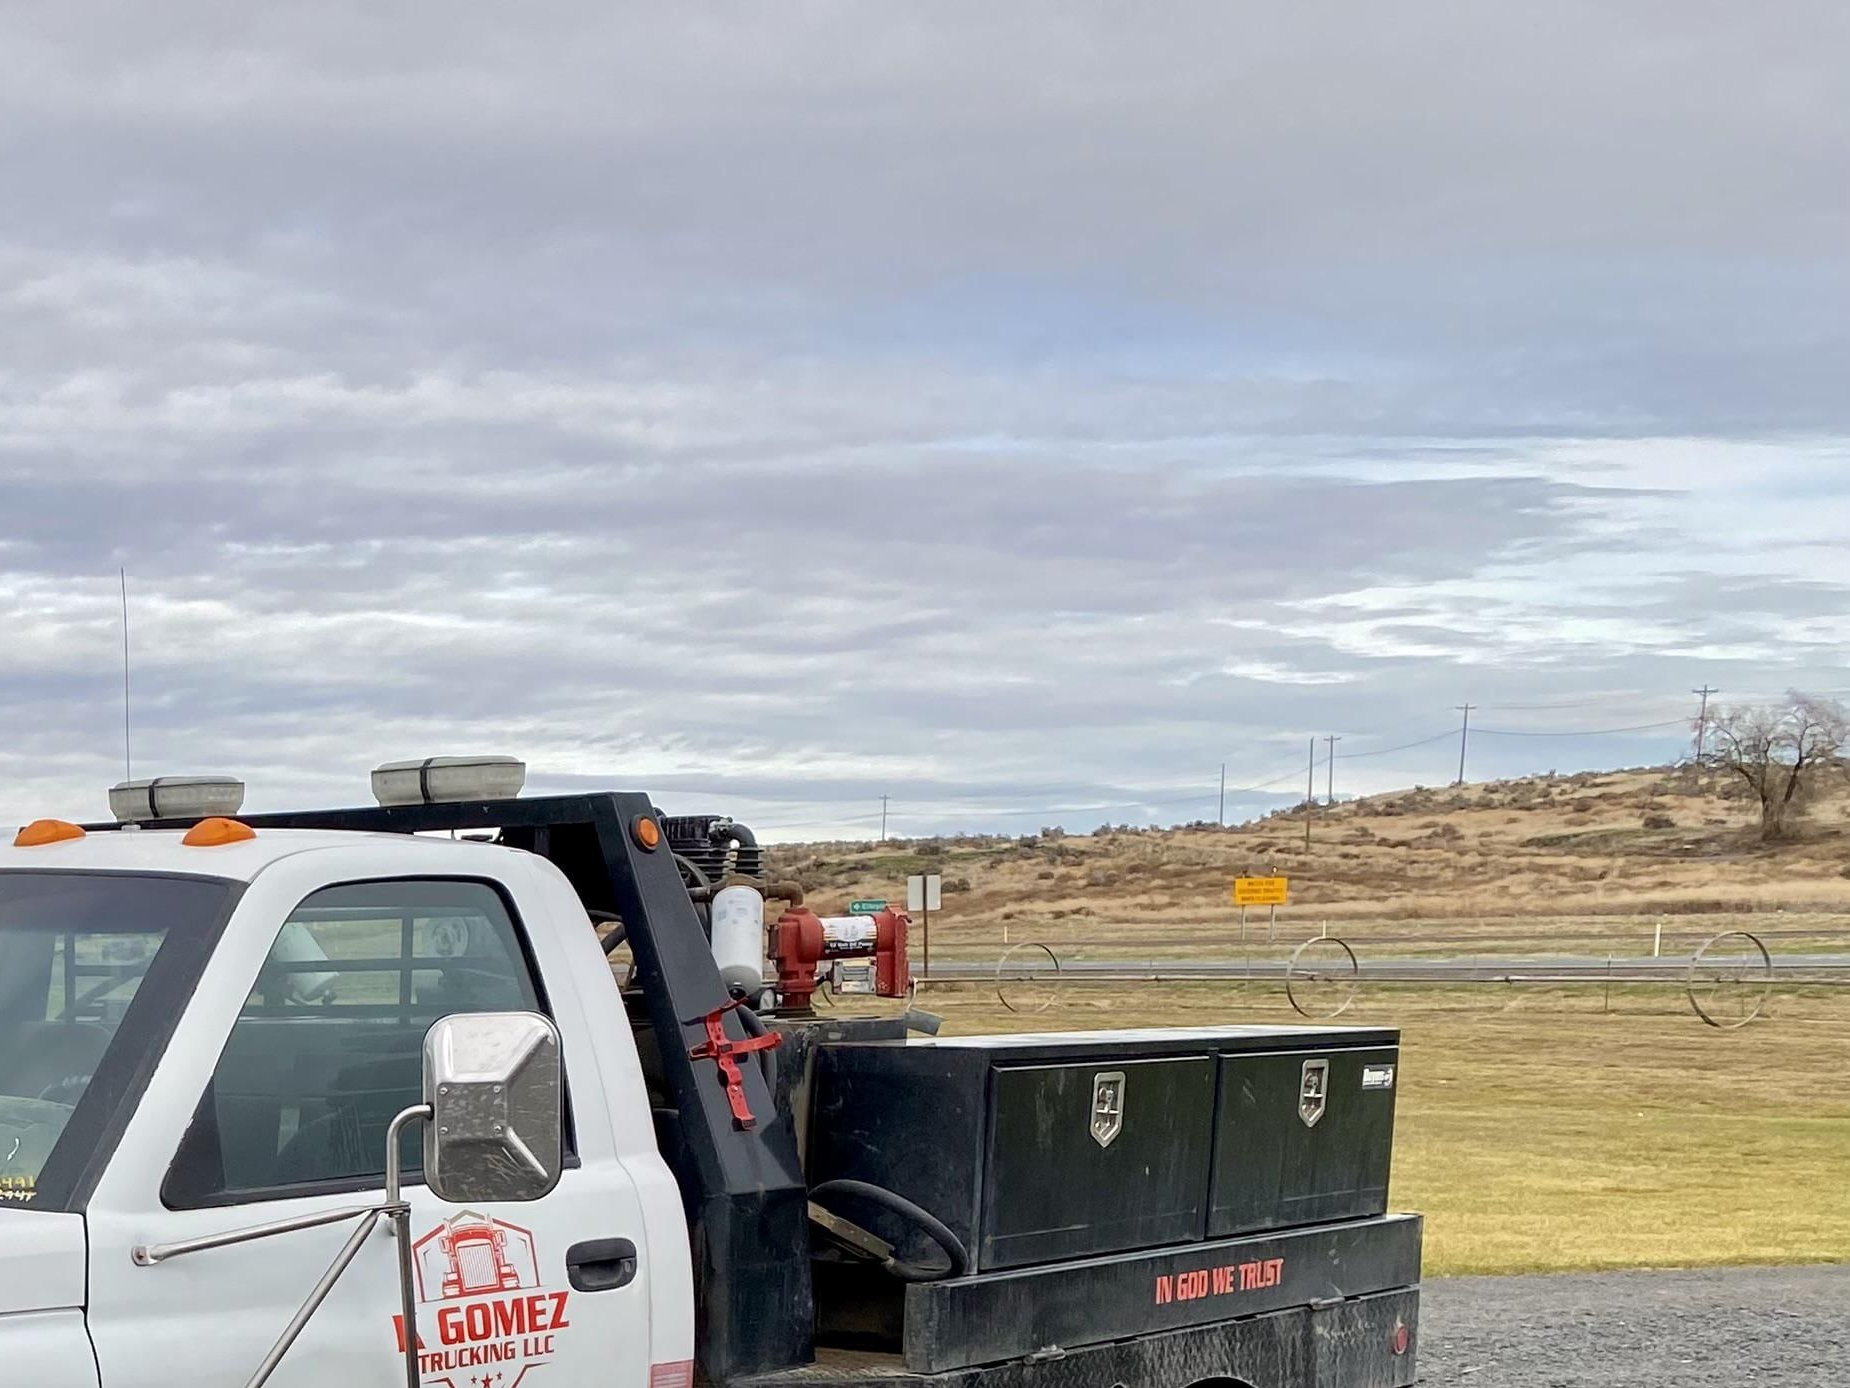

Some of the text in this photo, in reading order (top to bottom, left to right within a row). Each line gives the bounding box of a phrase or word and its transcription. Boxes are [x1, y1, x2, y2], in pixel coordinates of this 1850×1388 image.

[1156, 1258, 1285, 1305] IN GOD WE TRUST
[437, 1290, 570, 1346] GOMEZ
[418, 1335, 555, 1374] TRUCKING LLC
